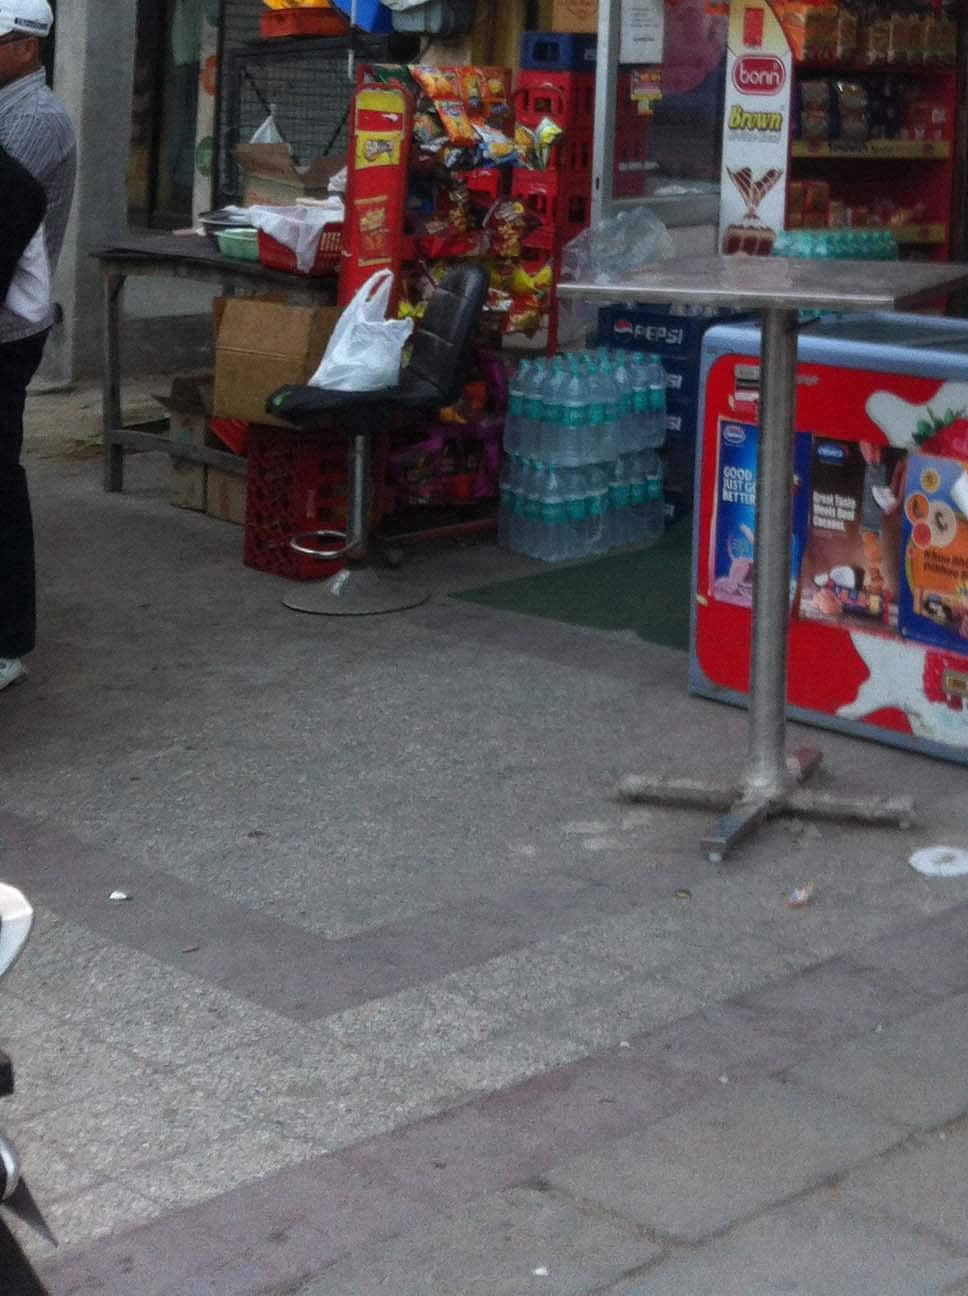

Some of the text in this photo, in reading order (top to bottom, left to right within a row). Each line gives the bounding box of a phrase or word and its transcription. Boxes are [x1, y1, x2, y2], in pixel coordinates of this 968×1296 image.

[739, 63, 780, 86] bonn
[729, 104, 783, 132] Brown
[634, 323, 684, 345] PEPSI
[723, 466, 753, 481] GOOD
[723, 478, 744, 491] JUST
[722, 490, 756, 505] BETTER
